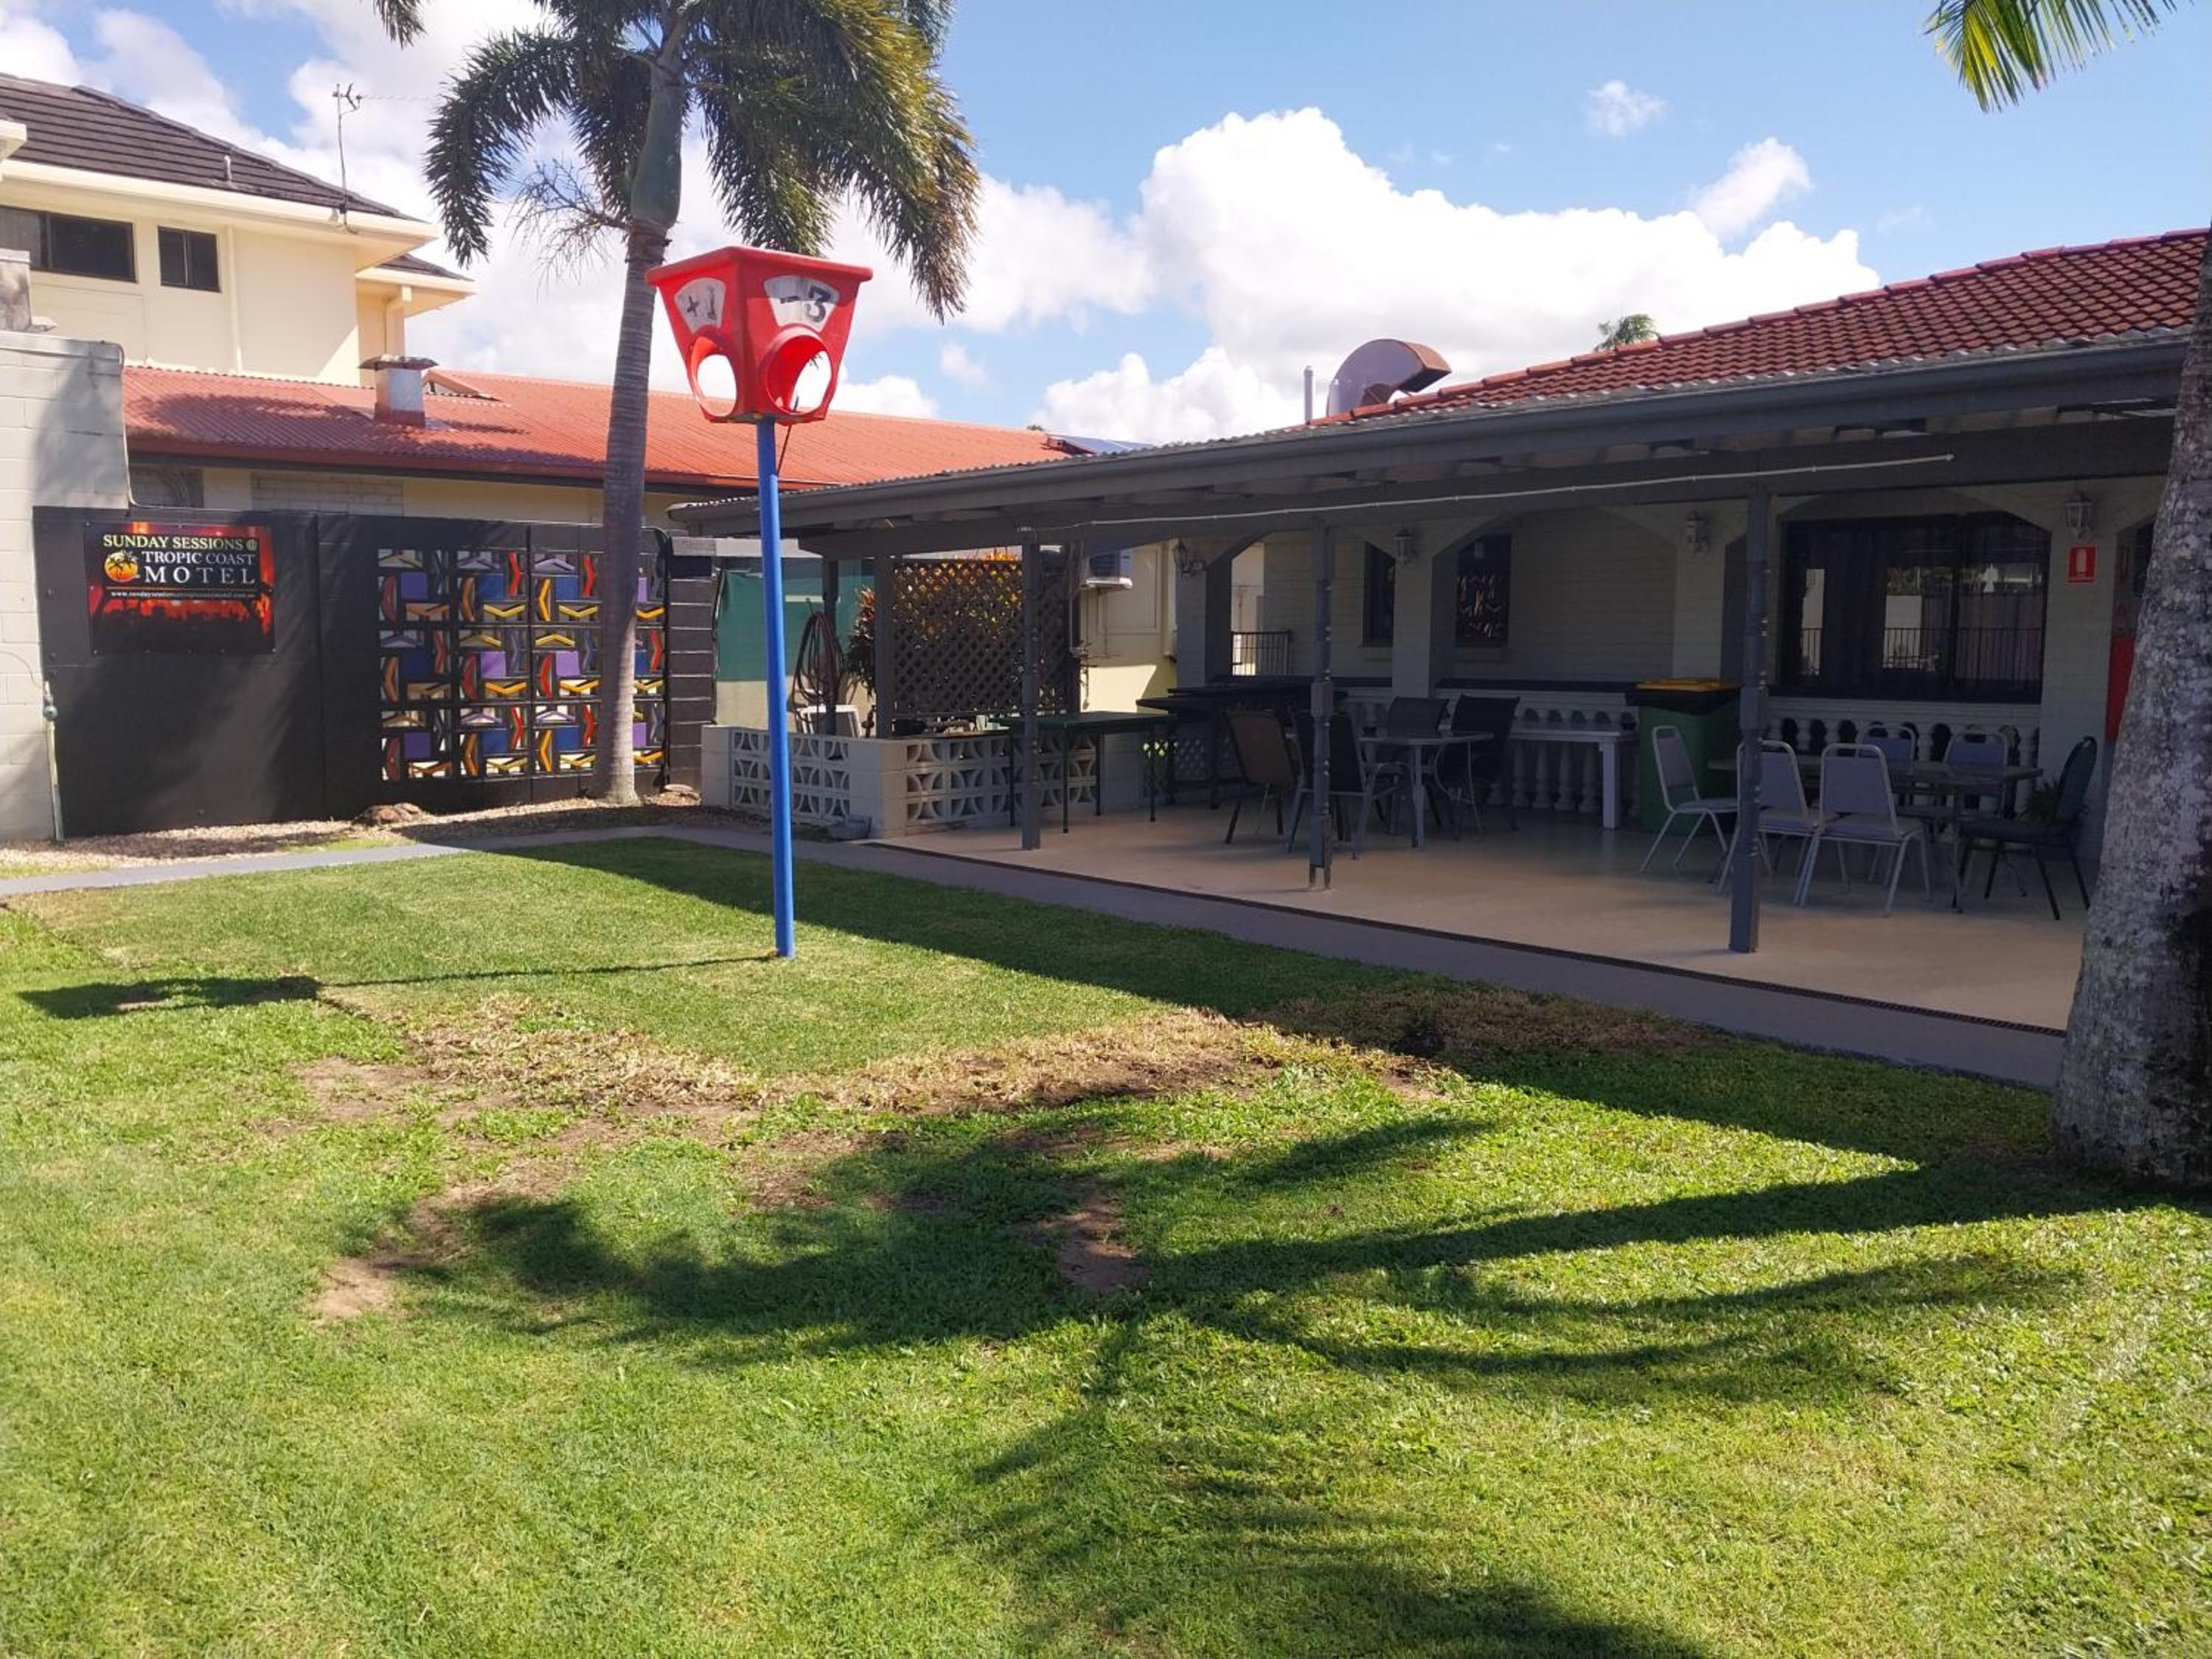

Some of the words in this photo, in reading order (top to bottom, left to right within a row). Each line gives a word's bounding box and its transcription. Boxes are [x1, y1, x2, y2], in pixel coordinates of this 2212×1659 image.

[102, 534, 169, 549] SUNDAY
[172, 536, 243, 551] SESSIONS
[142, 551, 203, 565] TROPIC
[206, 553, 255, 566] COAST
[145, 566, 255, 584] MOTEL
